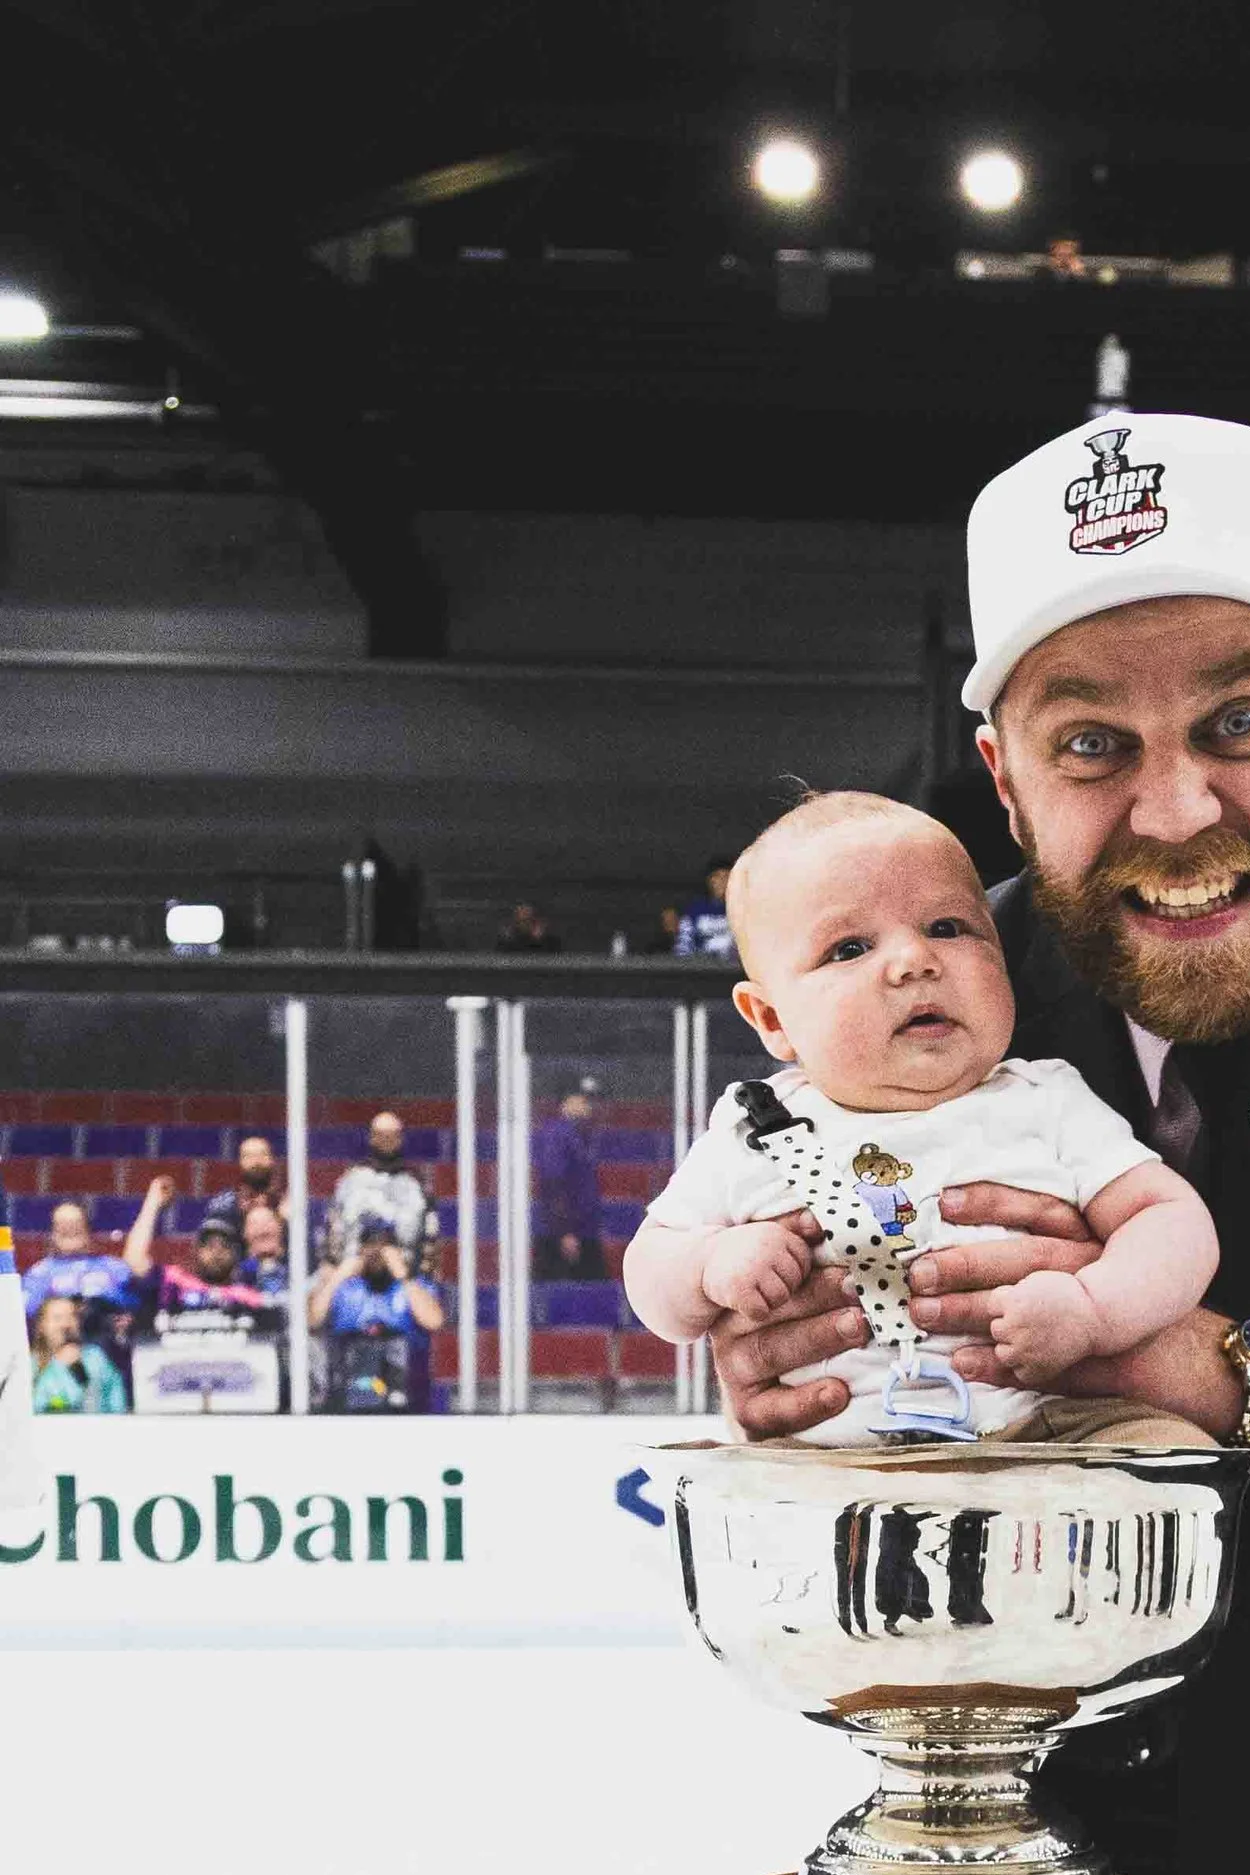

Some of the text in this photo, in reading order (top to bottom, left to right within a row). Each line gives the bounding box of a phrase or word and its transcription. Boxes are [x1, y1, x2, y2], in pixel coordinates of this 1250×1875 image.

[1068, 468, 1157, 507] CLARK
[1086, 490, 1142, 523] CUP
[1072, 510, 1164, 549] CHAMPIONS
